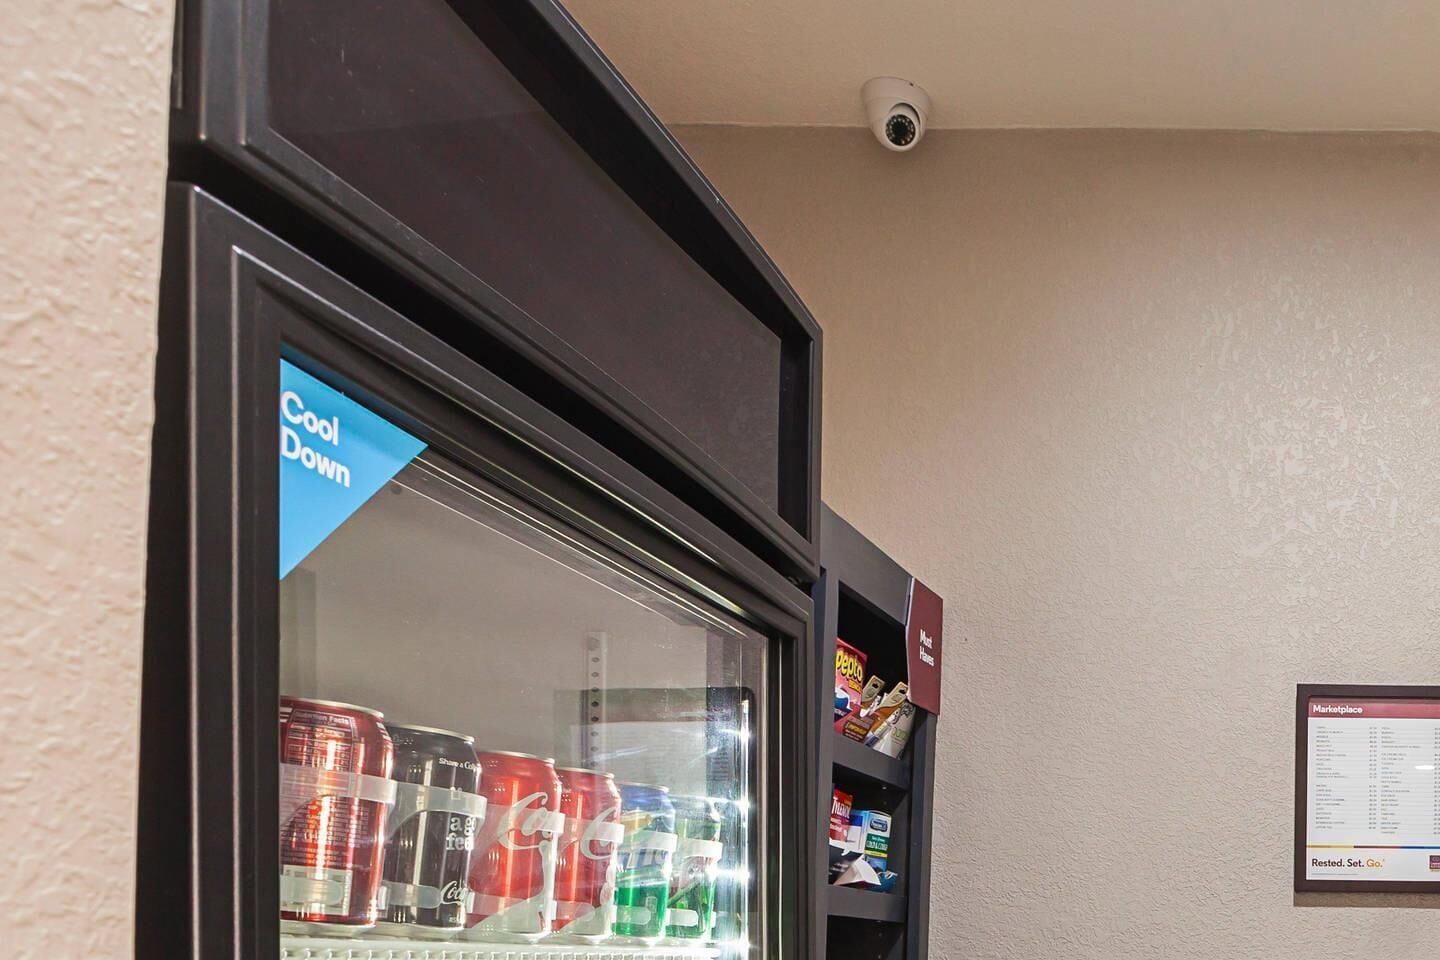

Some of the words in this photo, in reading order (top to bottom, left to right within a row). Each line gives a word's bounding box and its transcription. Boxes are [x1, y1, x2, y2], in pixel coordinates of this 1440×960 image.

[280, 390, 339, 446] Cool
[280, 424, 351, 488] Down
[920, 628, 932, 649] Must
[919, 646, 935, 667] Haves
[1312, 704, 1363, 715] Marketplace
[1311, 858, 1345, 868] Rested.
[1346, 858, 1365, 868] Set.
